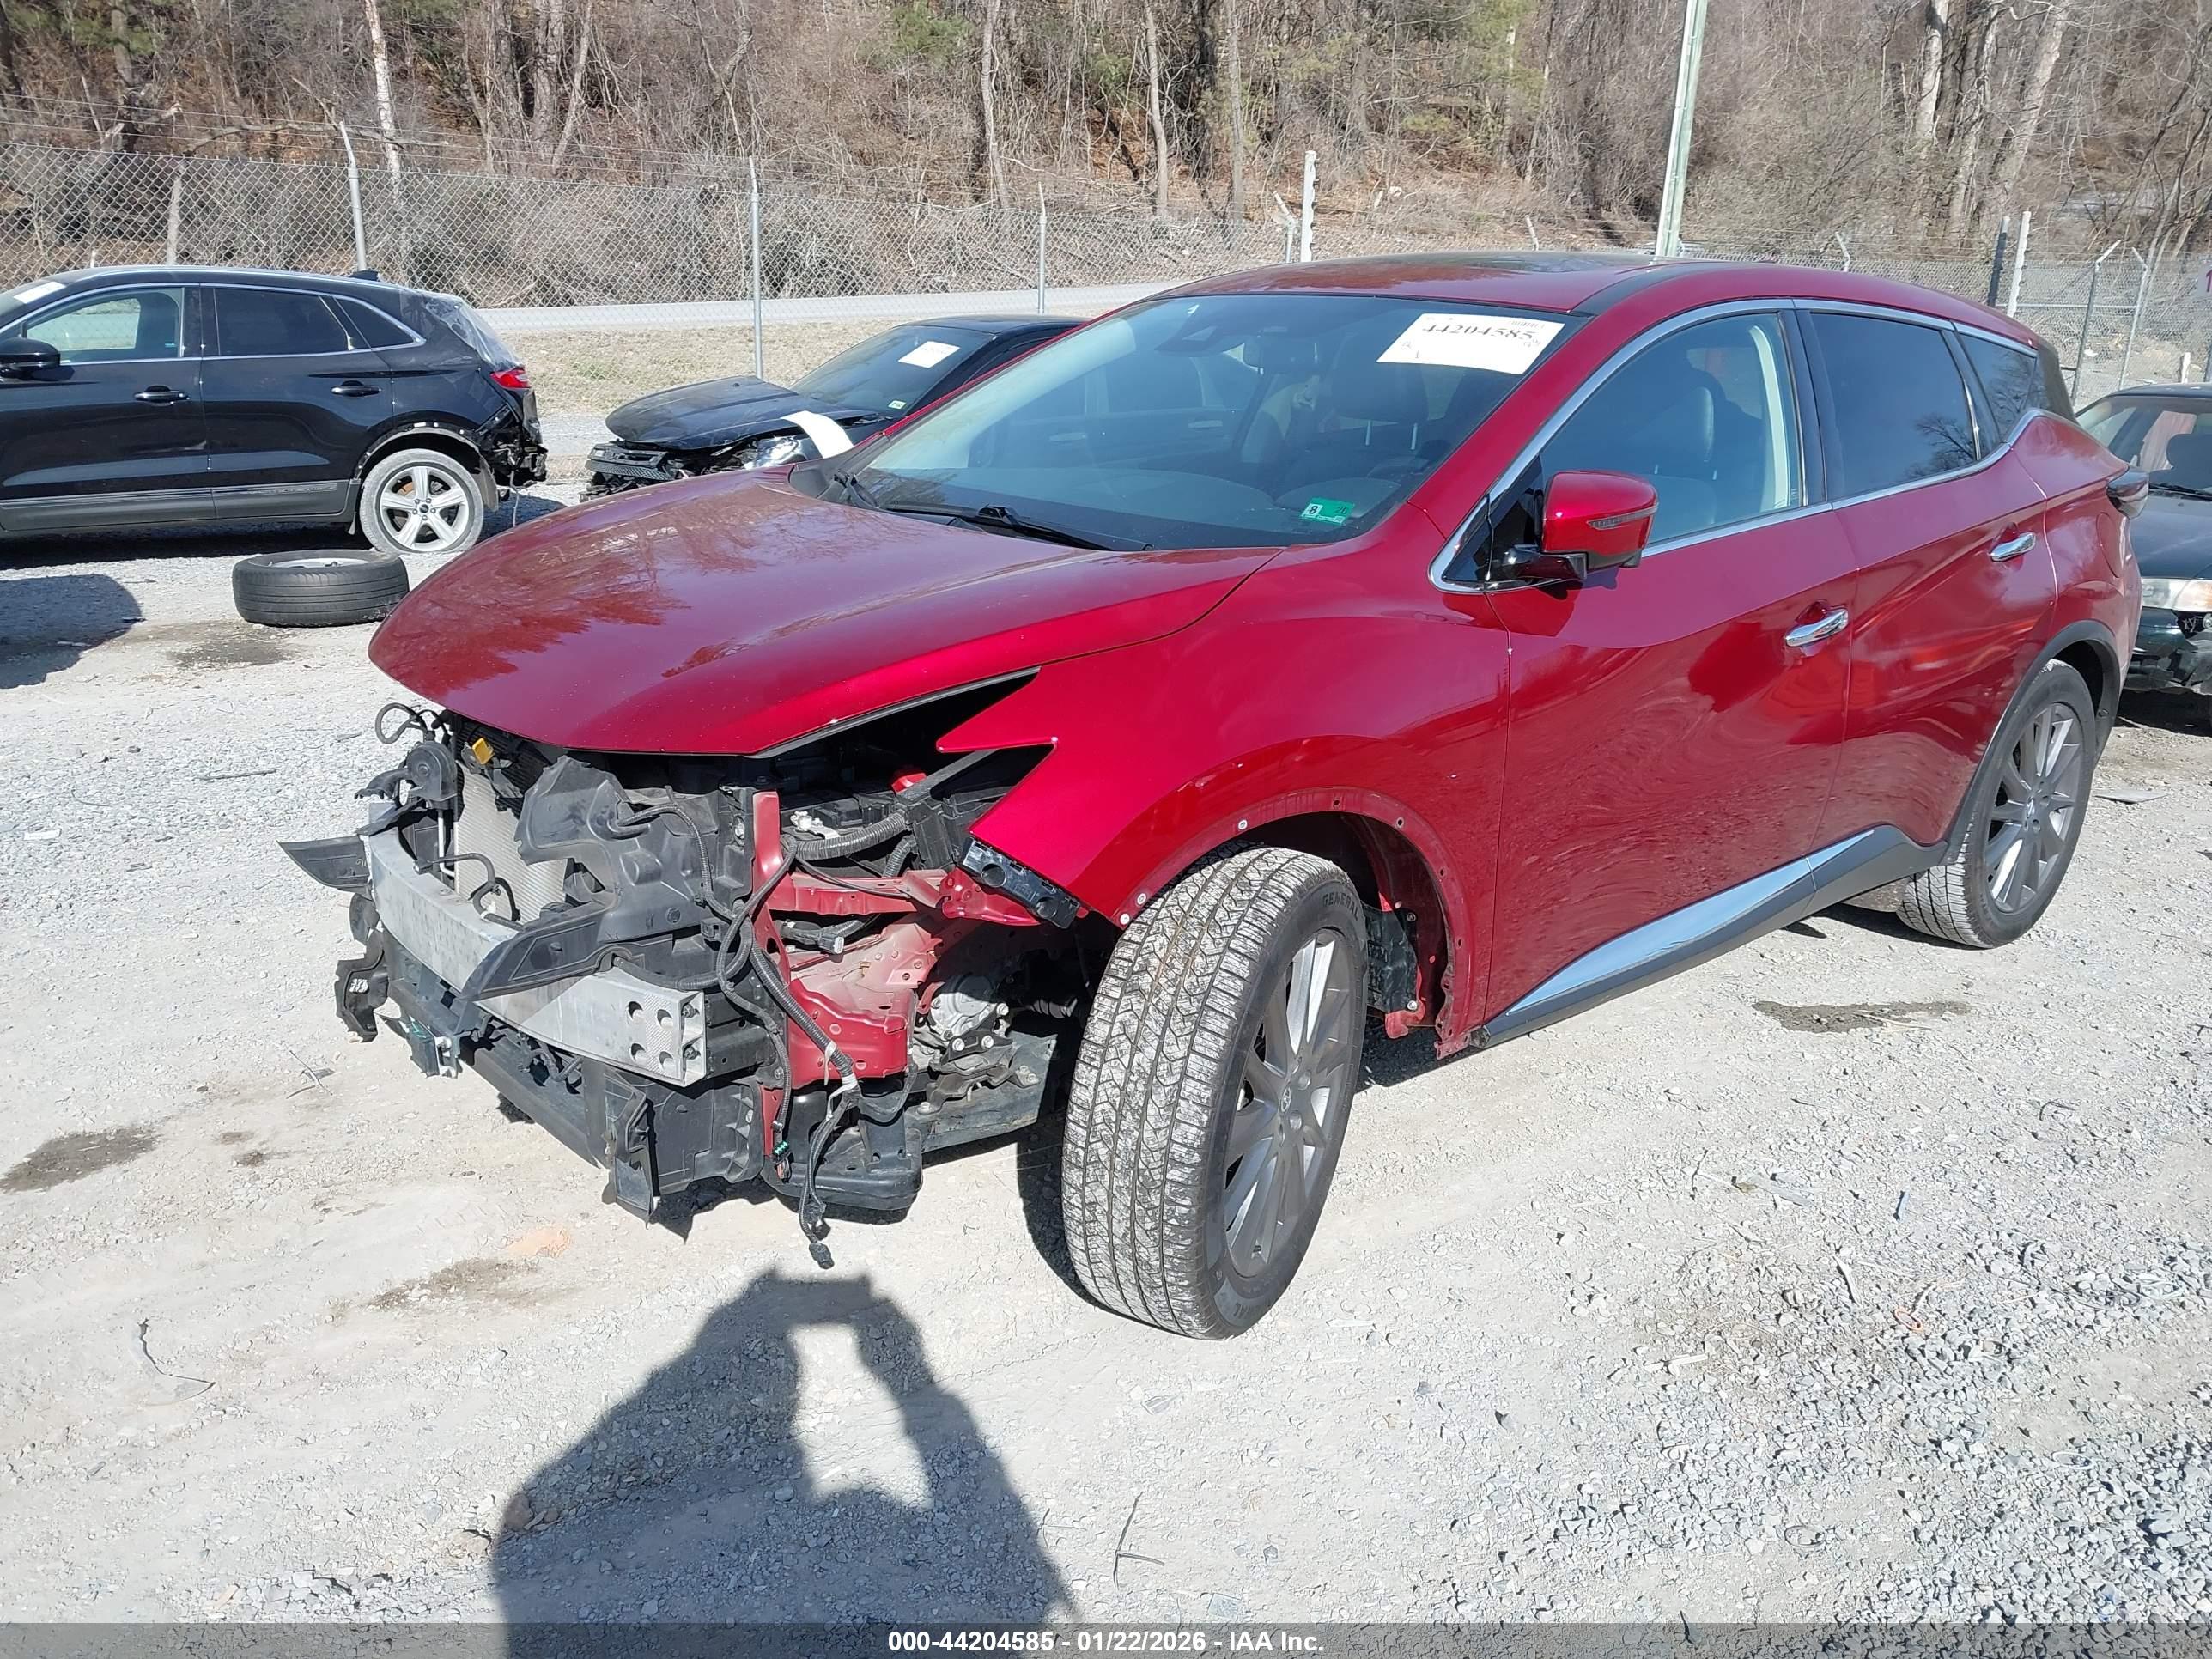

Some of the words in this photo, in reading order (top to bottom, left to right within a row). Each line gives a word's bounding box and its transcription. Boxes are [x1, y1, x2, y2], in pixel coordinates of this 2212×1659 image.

[1422, 324, 1536, 340] 44204585
[1309, 505, 1318, 514] 8
[1322, 891, 1358, 921] GENERAL
